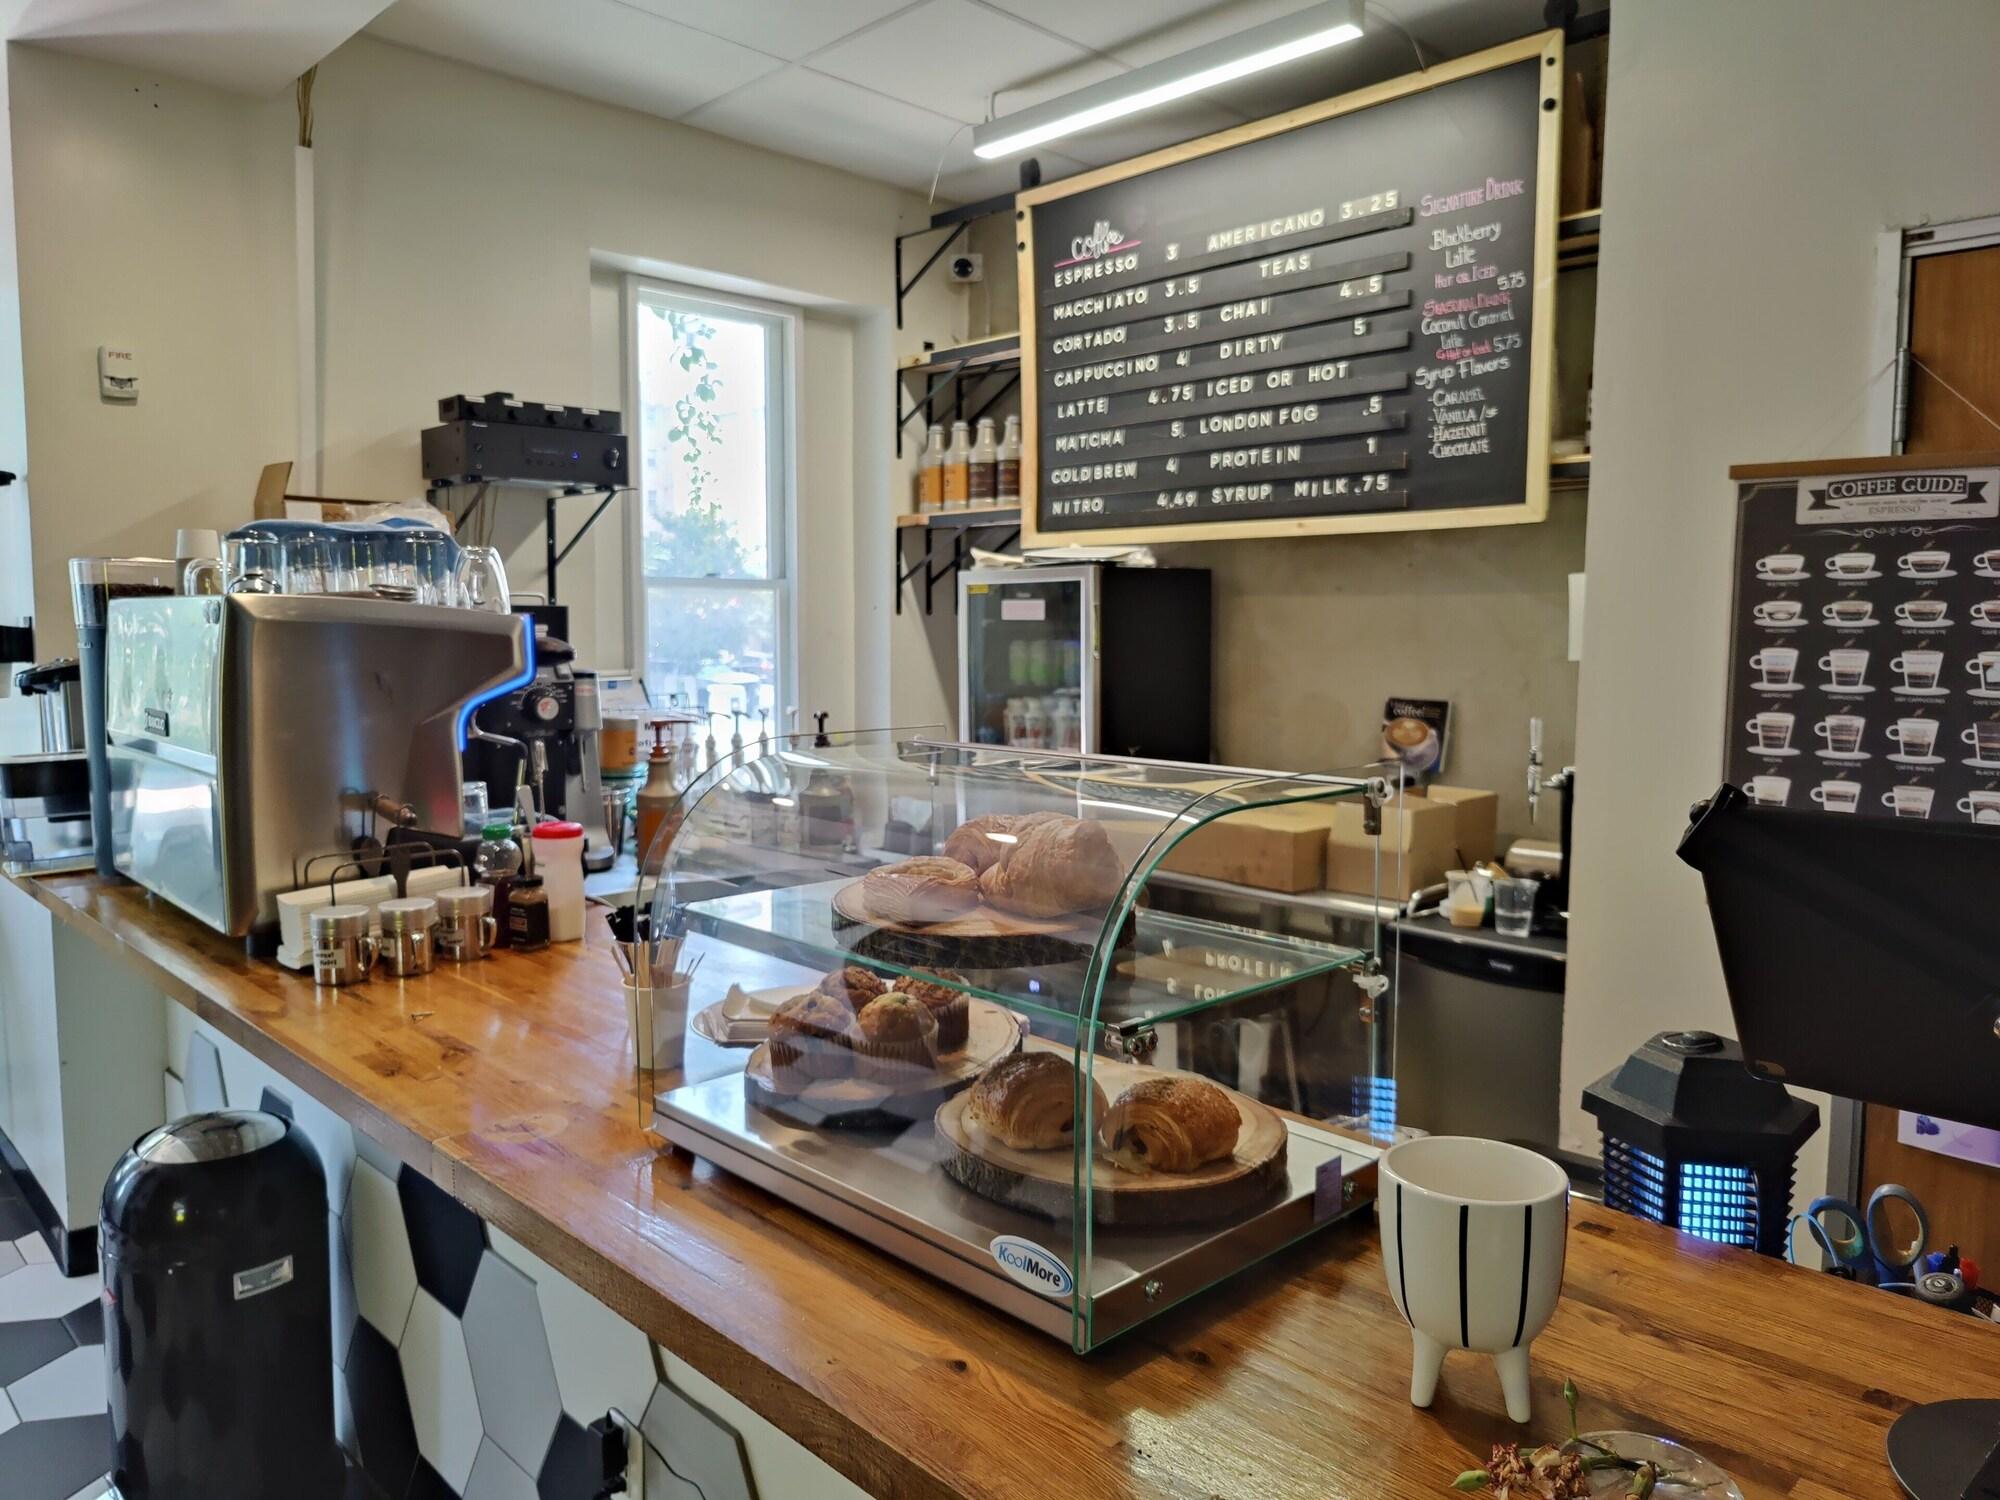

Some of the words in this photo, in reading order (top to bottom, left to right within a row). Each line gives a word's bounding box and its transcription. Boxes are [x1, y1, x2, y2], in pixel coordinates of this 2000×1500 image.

[1486, 177, 1525, 201] DRINK
[1208, 208, 1324, 251] AMERICANO
[1341, 190, 1398, 221] 3.25
[1428, 222, 1501, 251] Blackberry
[1054, 254, 1139, 287] ESPRESSO
[1166, 243, 1179, 261] 3
[1260, 253, 1311, 278] TEAS
[1445, 245, 1477, 269] Latte
[1053, 287, 1149, 320] MACCHIATO
[1165, 277, 1200, 298] 3.5
[1220, 298, 1270, 322] CHAI
[1340, 275, 1383, 298] 4.5
[1053, 326, 1126, 354] CORTADO
[1164, 313, 1200, 334] 3.5
[1220, 333, 1284, 360] DIRTY
[1353, 318, 1368, 335] 5
[1421, 314, 1468, 335] Coconut
[108, 351, 132, 361] FIRE
[1054, 354, 1159, 387] CAPPUCCINO
[1176, 351, 1190, 367] 4
[1207, 375, 1254, 397] ICED
[1266, 370, 1294, 389] OR
[1308, 361, 1349, 383] HOT
[1414, 366, 1456, 390] Syrup
[1456, 356, 1511, 379] Flavors
[1057, 397, 1109, 418] LATTE
[1148, 384, 1195, 405] 4.75
[1200, 410, 1273, 434] LONDON
[1279, 404, 1319, 424] FOG
[1362, 396, 1383, 416] .5
[1055, 429, 1126, 452] MATCHA
[1210, 445, 1301, 469] PROTEIN
[1366, 437, 1378, 455] 1
[1166, 457, 1179, 474] 4
[1211, 484, 1273, 504] SYRUP
[1294, 478, 1348, 498] MILK
[1354, 474, 1390, 494] .75
[1828, 478, 1897, 498] COFFEE
[1901, 476, 1965, 493] GUIDE
[1052, 497, 1105, 515] NITRO
[1868, 504, 1920, 515] ESPRESSO
[998, 1245, 1061, 1288] KoolMore
